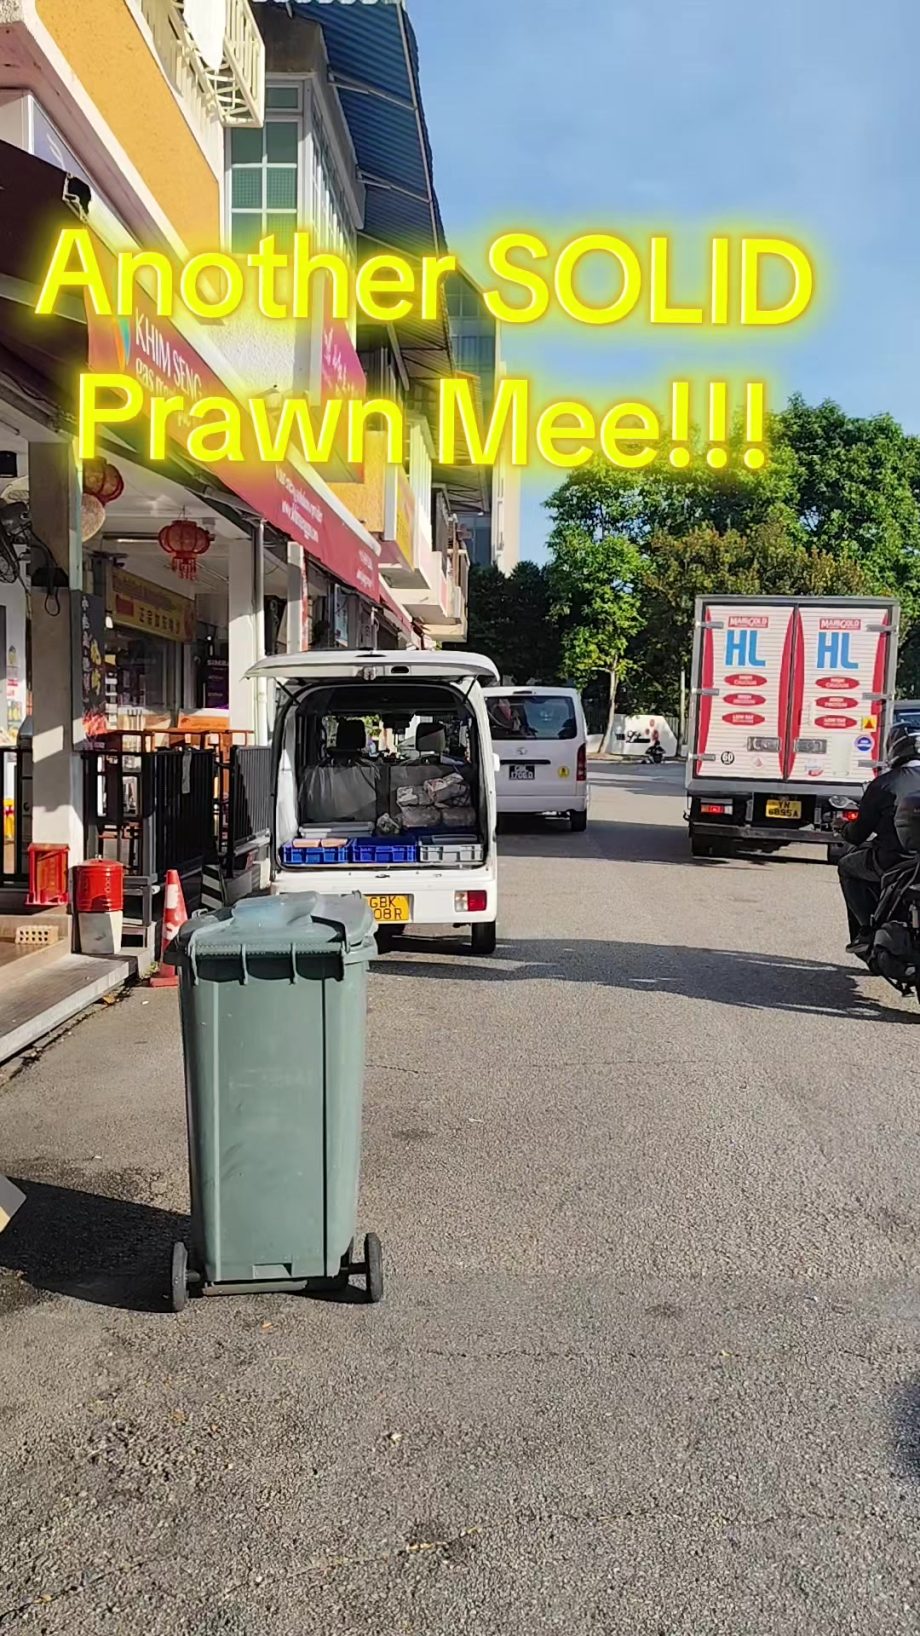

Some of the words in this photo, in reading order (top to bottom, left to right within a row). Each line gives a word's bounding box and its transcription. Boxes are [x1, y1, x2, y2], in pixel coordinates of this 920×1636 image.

[136, 307, 171, 378] KHIM
[725, 630, 766, 667] HL
[816, 632, 858, 669] HL
[369, 895, 396, 908] GBK
[373, 908, 402, 920] 08R
